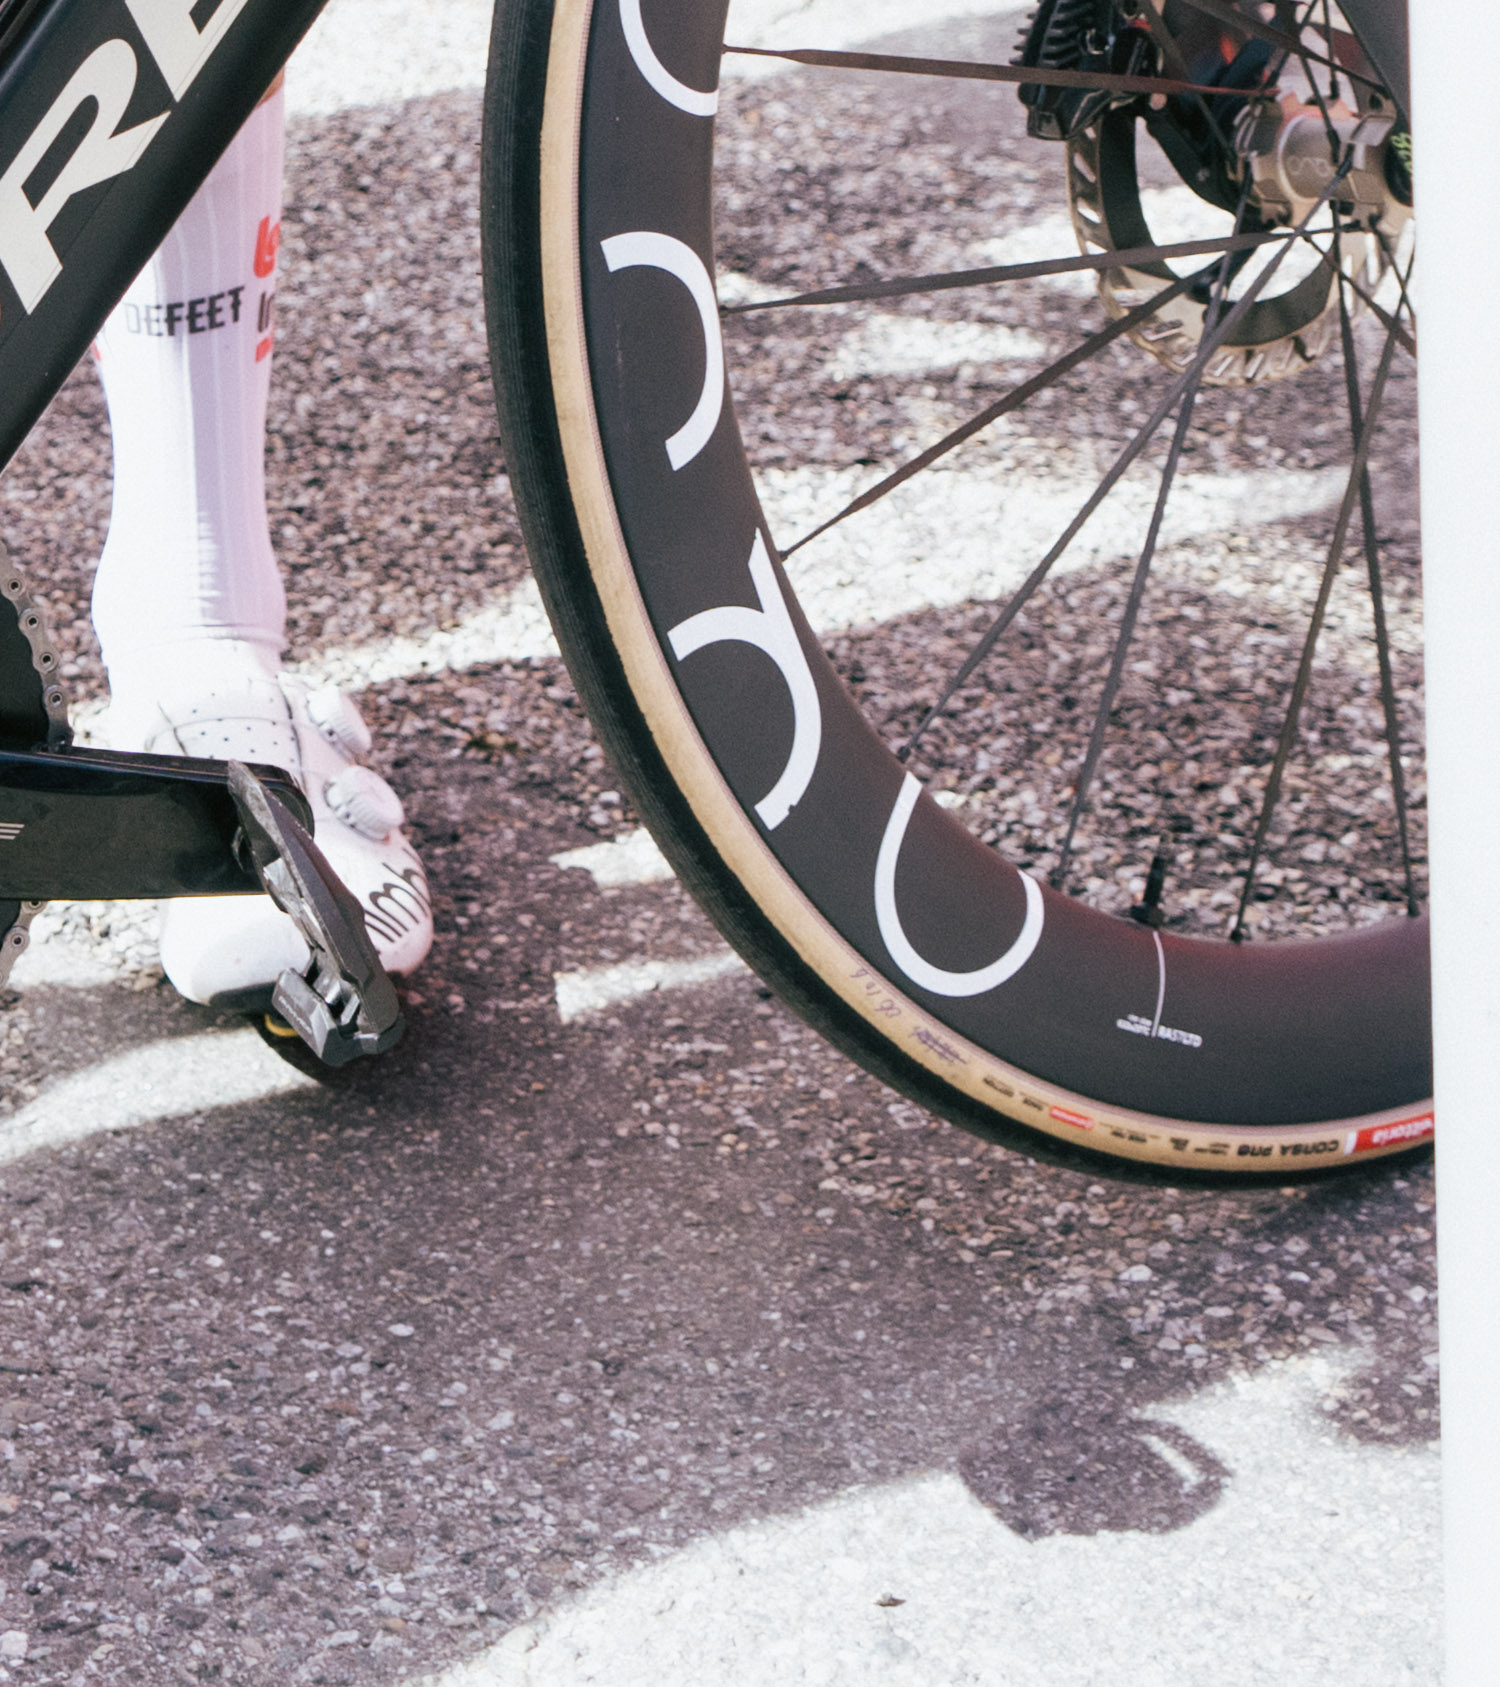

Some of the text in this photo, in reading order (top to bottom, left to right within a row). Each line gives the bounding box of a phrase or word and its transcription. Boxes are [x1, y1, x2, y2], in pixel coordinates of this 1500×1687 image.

[124, 284, 246, 337] DEFEET
[1236, 1143, 1273, 1158] PRO
[1279, 1138, 1340, 1158] CORSA
